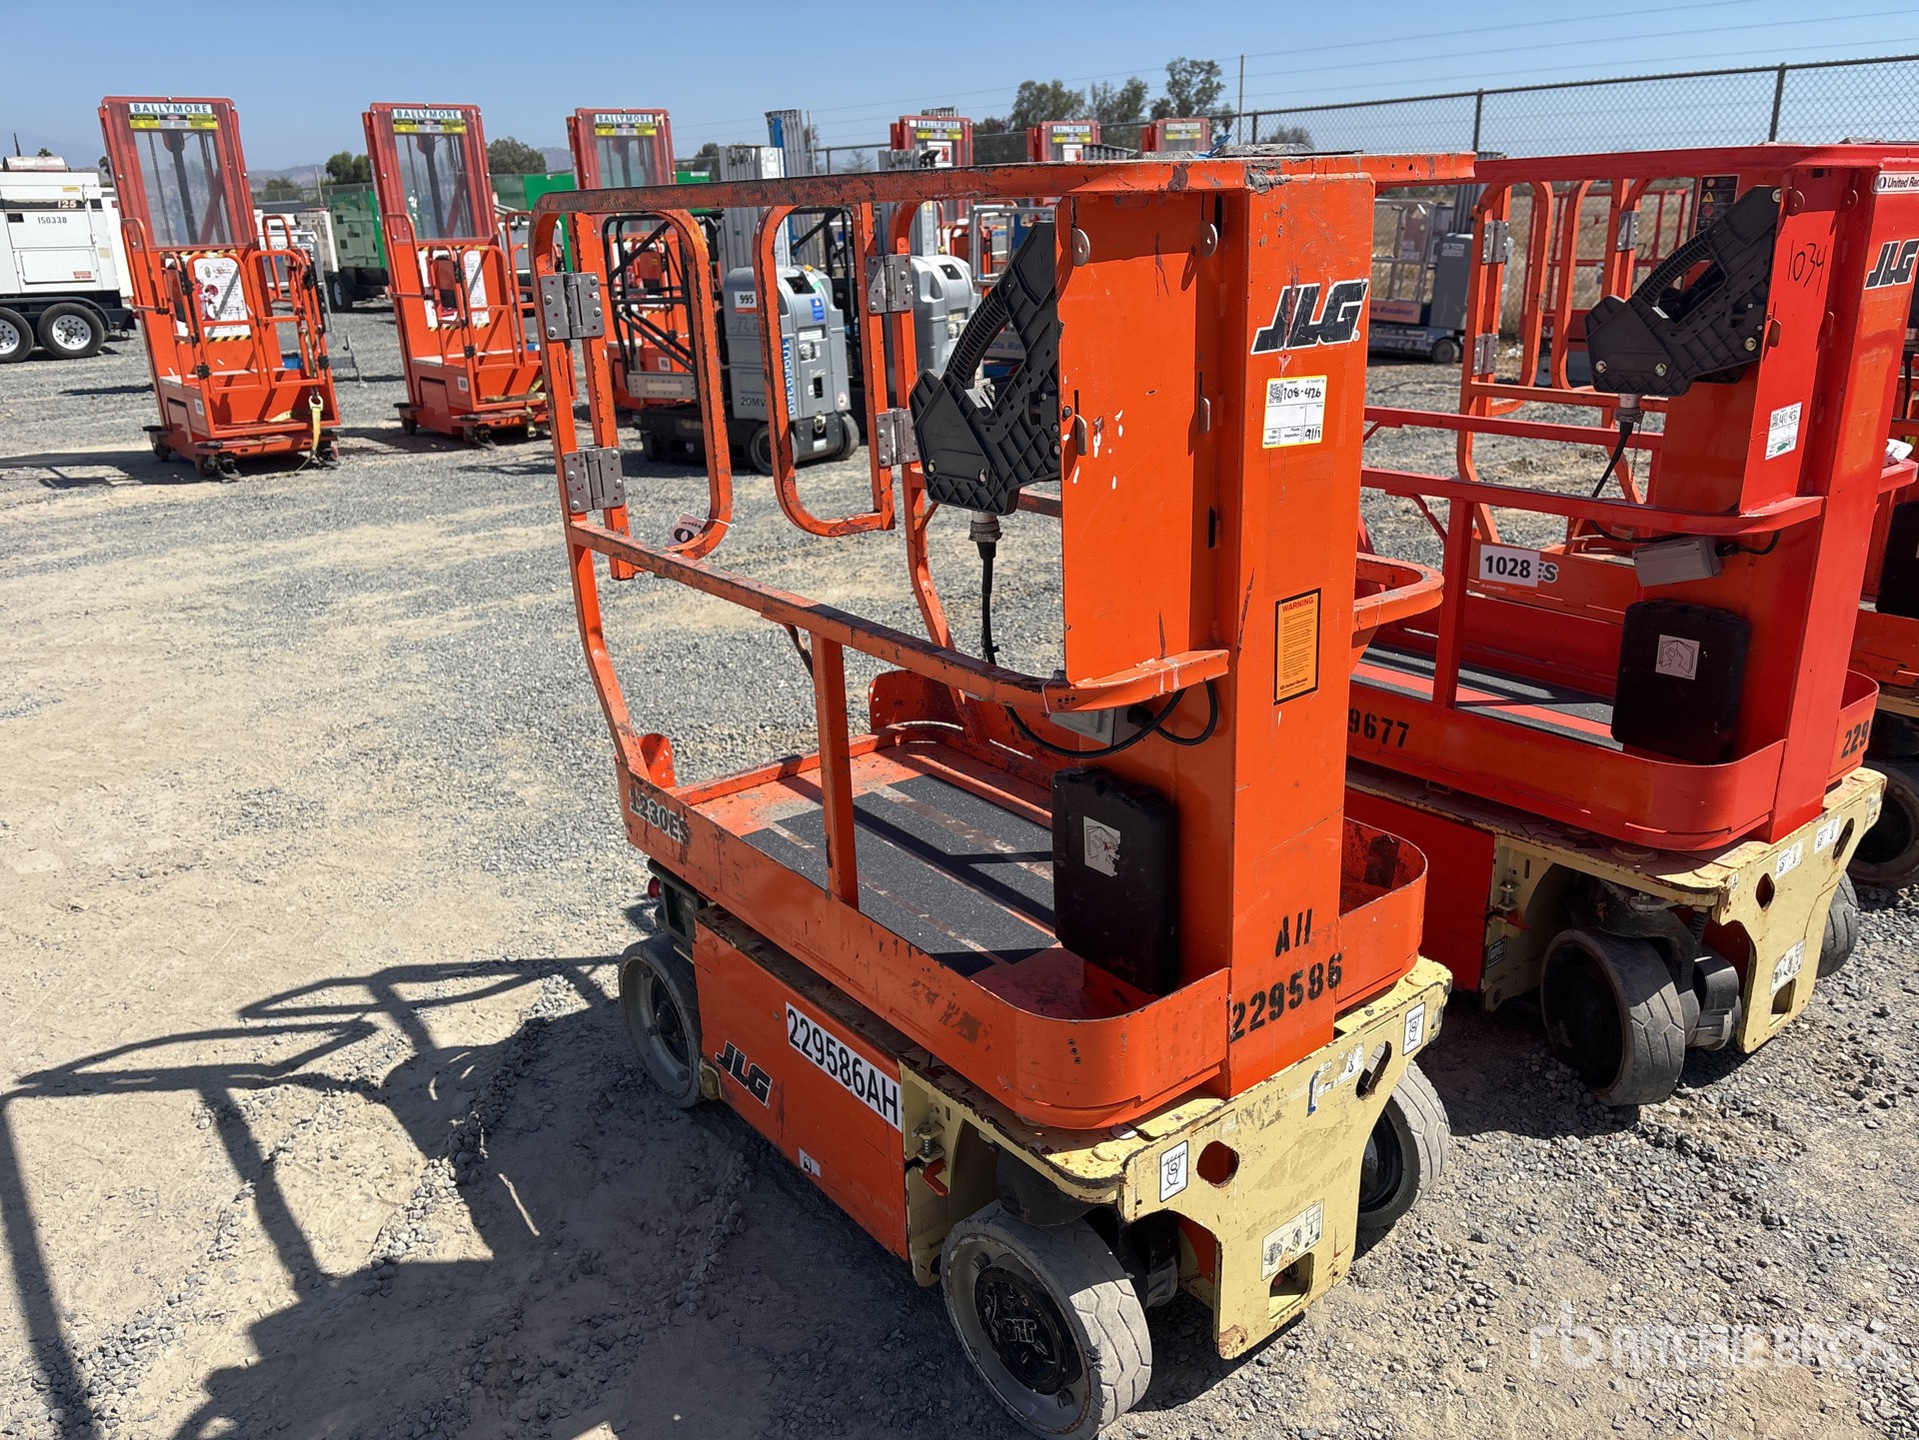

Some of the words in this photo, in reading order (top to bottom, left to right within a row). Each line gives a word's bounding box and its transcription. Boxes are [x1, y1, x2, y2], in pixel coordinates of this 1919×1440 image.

[134, 103, 208, 113] BALLYMORE
[396, 109, 459, 119] BALLYMORE
[598, 114, 650, 123] BALLYMORE
[1887, 176, 1909, 189] United
[57, 200, 77, 209] 125
[37, 216, 68, 224] 150338
[1786, 240, 1828, 297] 1034
[1863, 238, 1919, 290] JLG
[740, 294, 755, 304] 995
[1250, 278, 1370, 354] JLG
[1485, 554, 1531, 579] 1028
[1282, 596, 1314, 613] WARNING
[1230, 952, 1343, 1043] 229586
[714, 1040, 773, 1109] JLG
[787, 1008, 899, 1127] 229586AH
